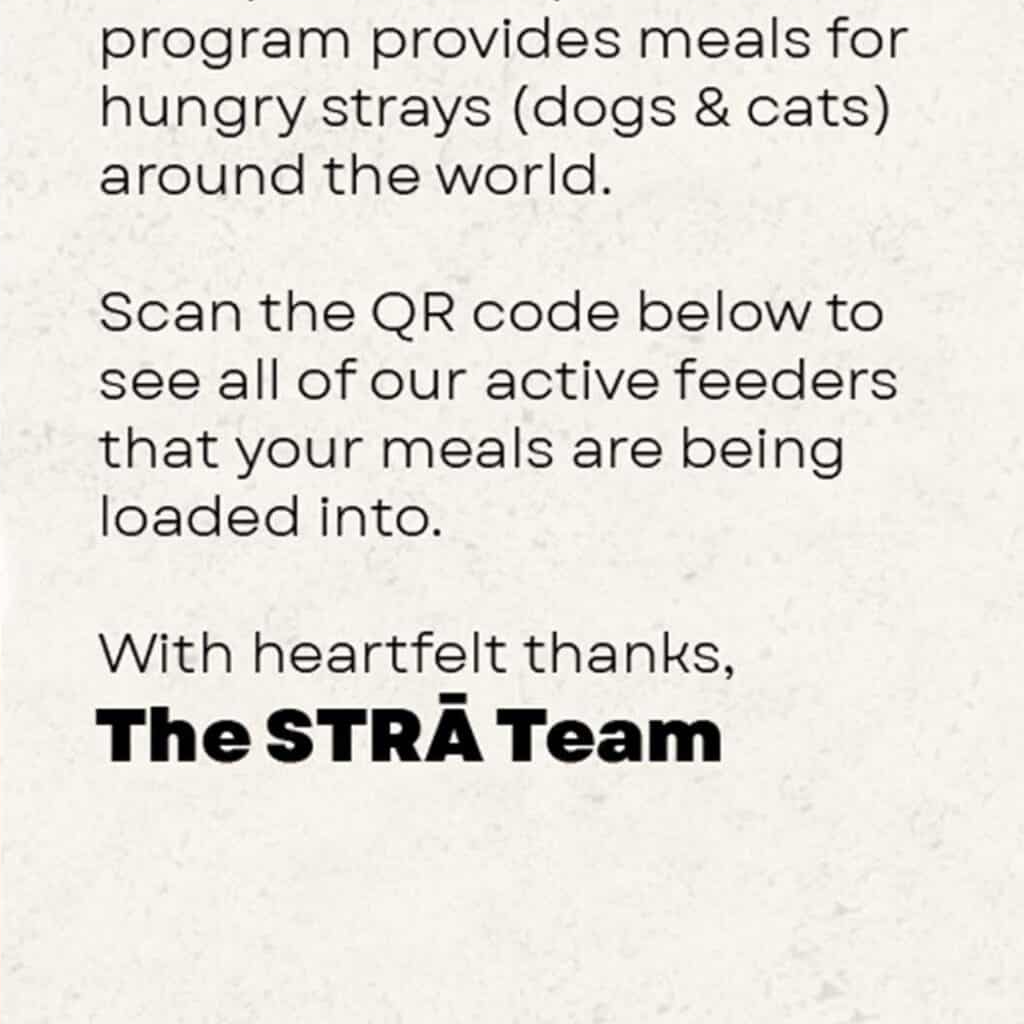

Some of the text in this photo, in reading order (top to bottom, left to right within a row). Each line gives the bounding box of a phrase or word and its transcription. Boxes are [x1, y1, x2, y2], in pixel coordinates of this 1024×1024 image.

[103, 16, 908, 69] program provides meals for
[103, 85, 888, 138] hungry strays (dogs & cats)
[101, 153, 610, 195] around the world.
[101, 290, 882, 340] Scan the QR code below to
[101, 358, 896, 400] see all of our active feeders
[99, 427, 842, 479] that your meals are being
[103, 495, 440, 536] loaded into.
[99, 631, 733, 679] With heartfelt thanks,
[96, 693, 720, 763] The STRĀ Team
